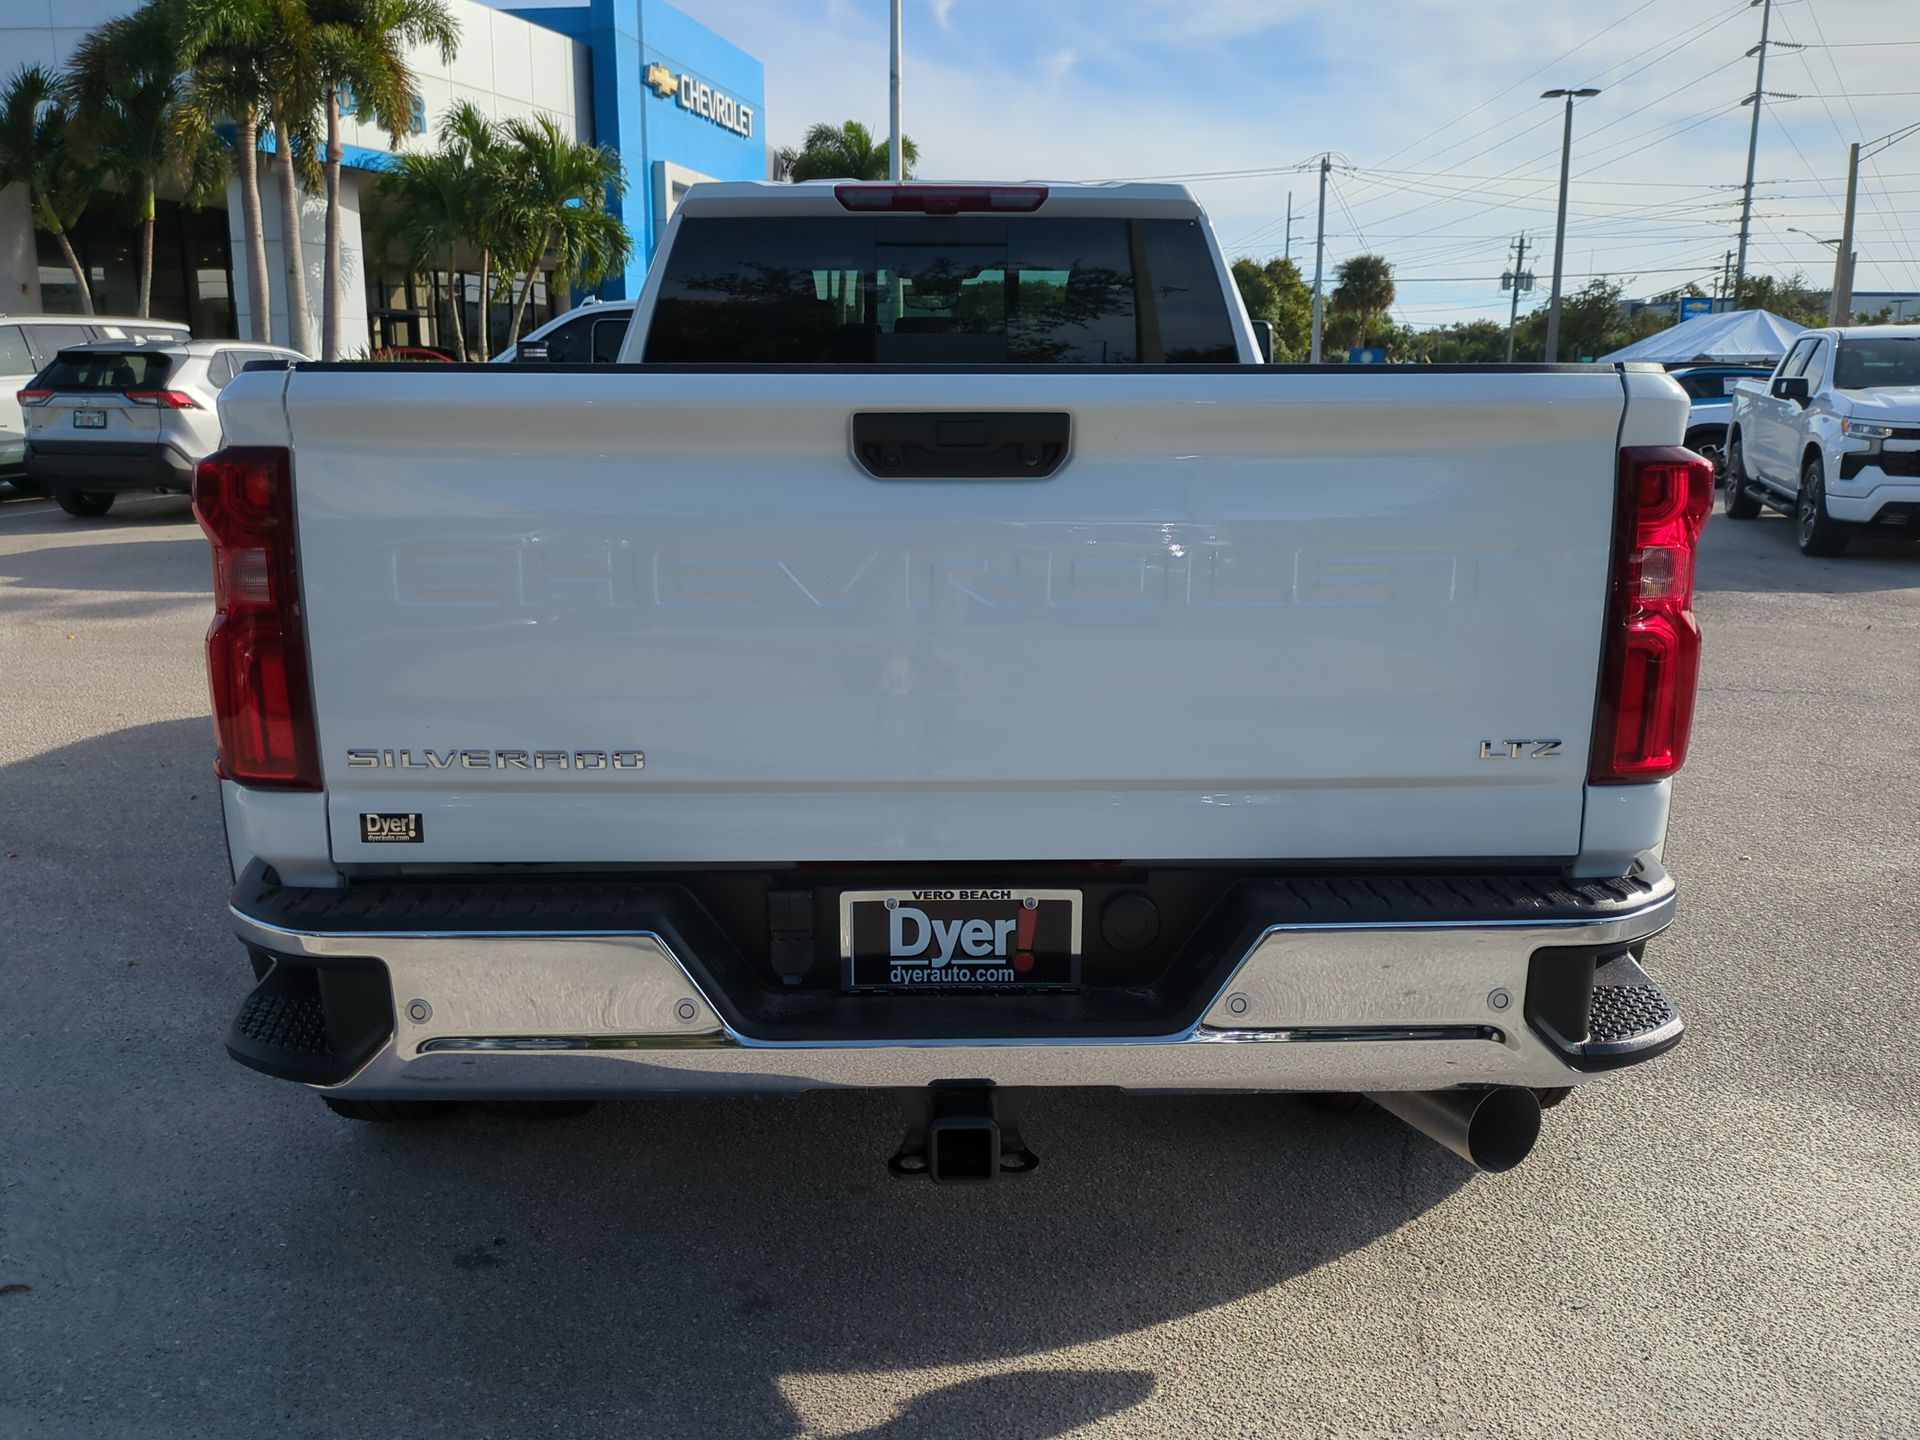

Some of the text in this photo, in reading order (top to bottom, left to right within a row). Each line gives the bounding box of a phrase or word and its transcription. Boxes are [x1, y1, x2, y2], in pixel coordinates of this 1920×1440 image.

[680, 73, 754, 138] CHEVROLET
[391, 545, 1522, 609] CHEVROLET
[347, 749, 645, 770] SILVERADO
[1480, 739, 1562, 759] LTZ
[366, 814, 416, 838] Dyer!
[911, 889, 1012, 900] VERO BEACH
[889, 906, 1038, 973] Dyer!
[890, 966, 1015, 985] dyerauto.com
